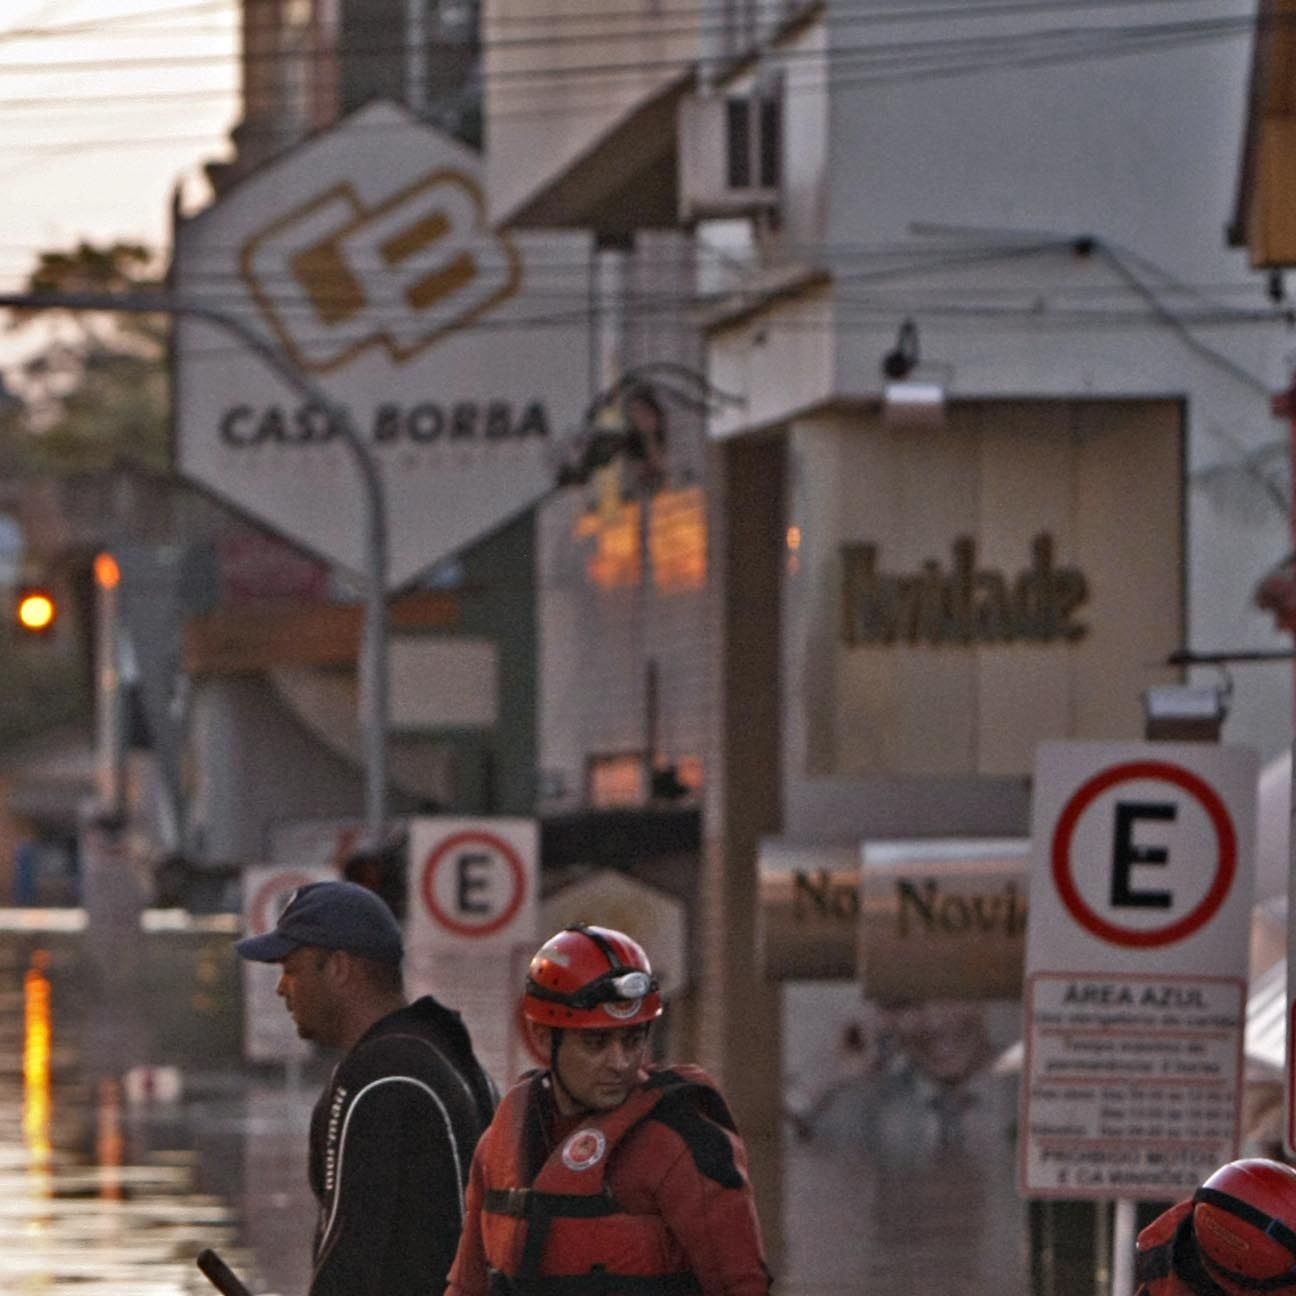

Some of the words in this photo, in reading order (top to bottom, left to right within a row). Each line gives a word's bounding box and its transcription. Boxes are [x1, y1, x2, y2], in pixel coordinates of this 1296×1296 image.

[375, 397, 549, 444] BORBA
[1109, 800, 1178, 908] E
[456, 852, 497, 914] E
[1139, 985, 1208, 1008] AZUL
